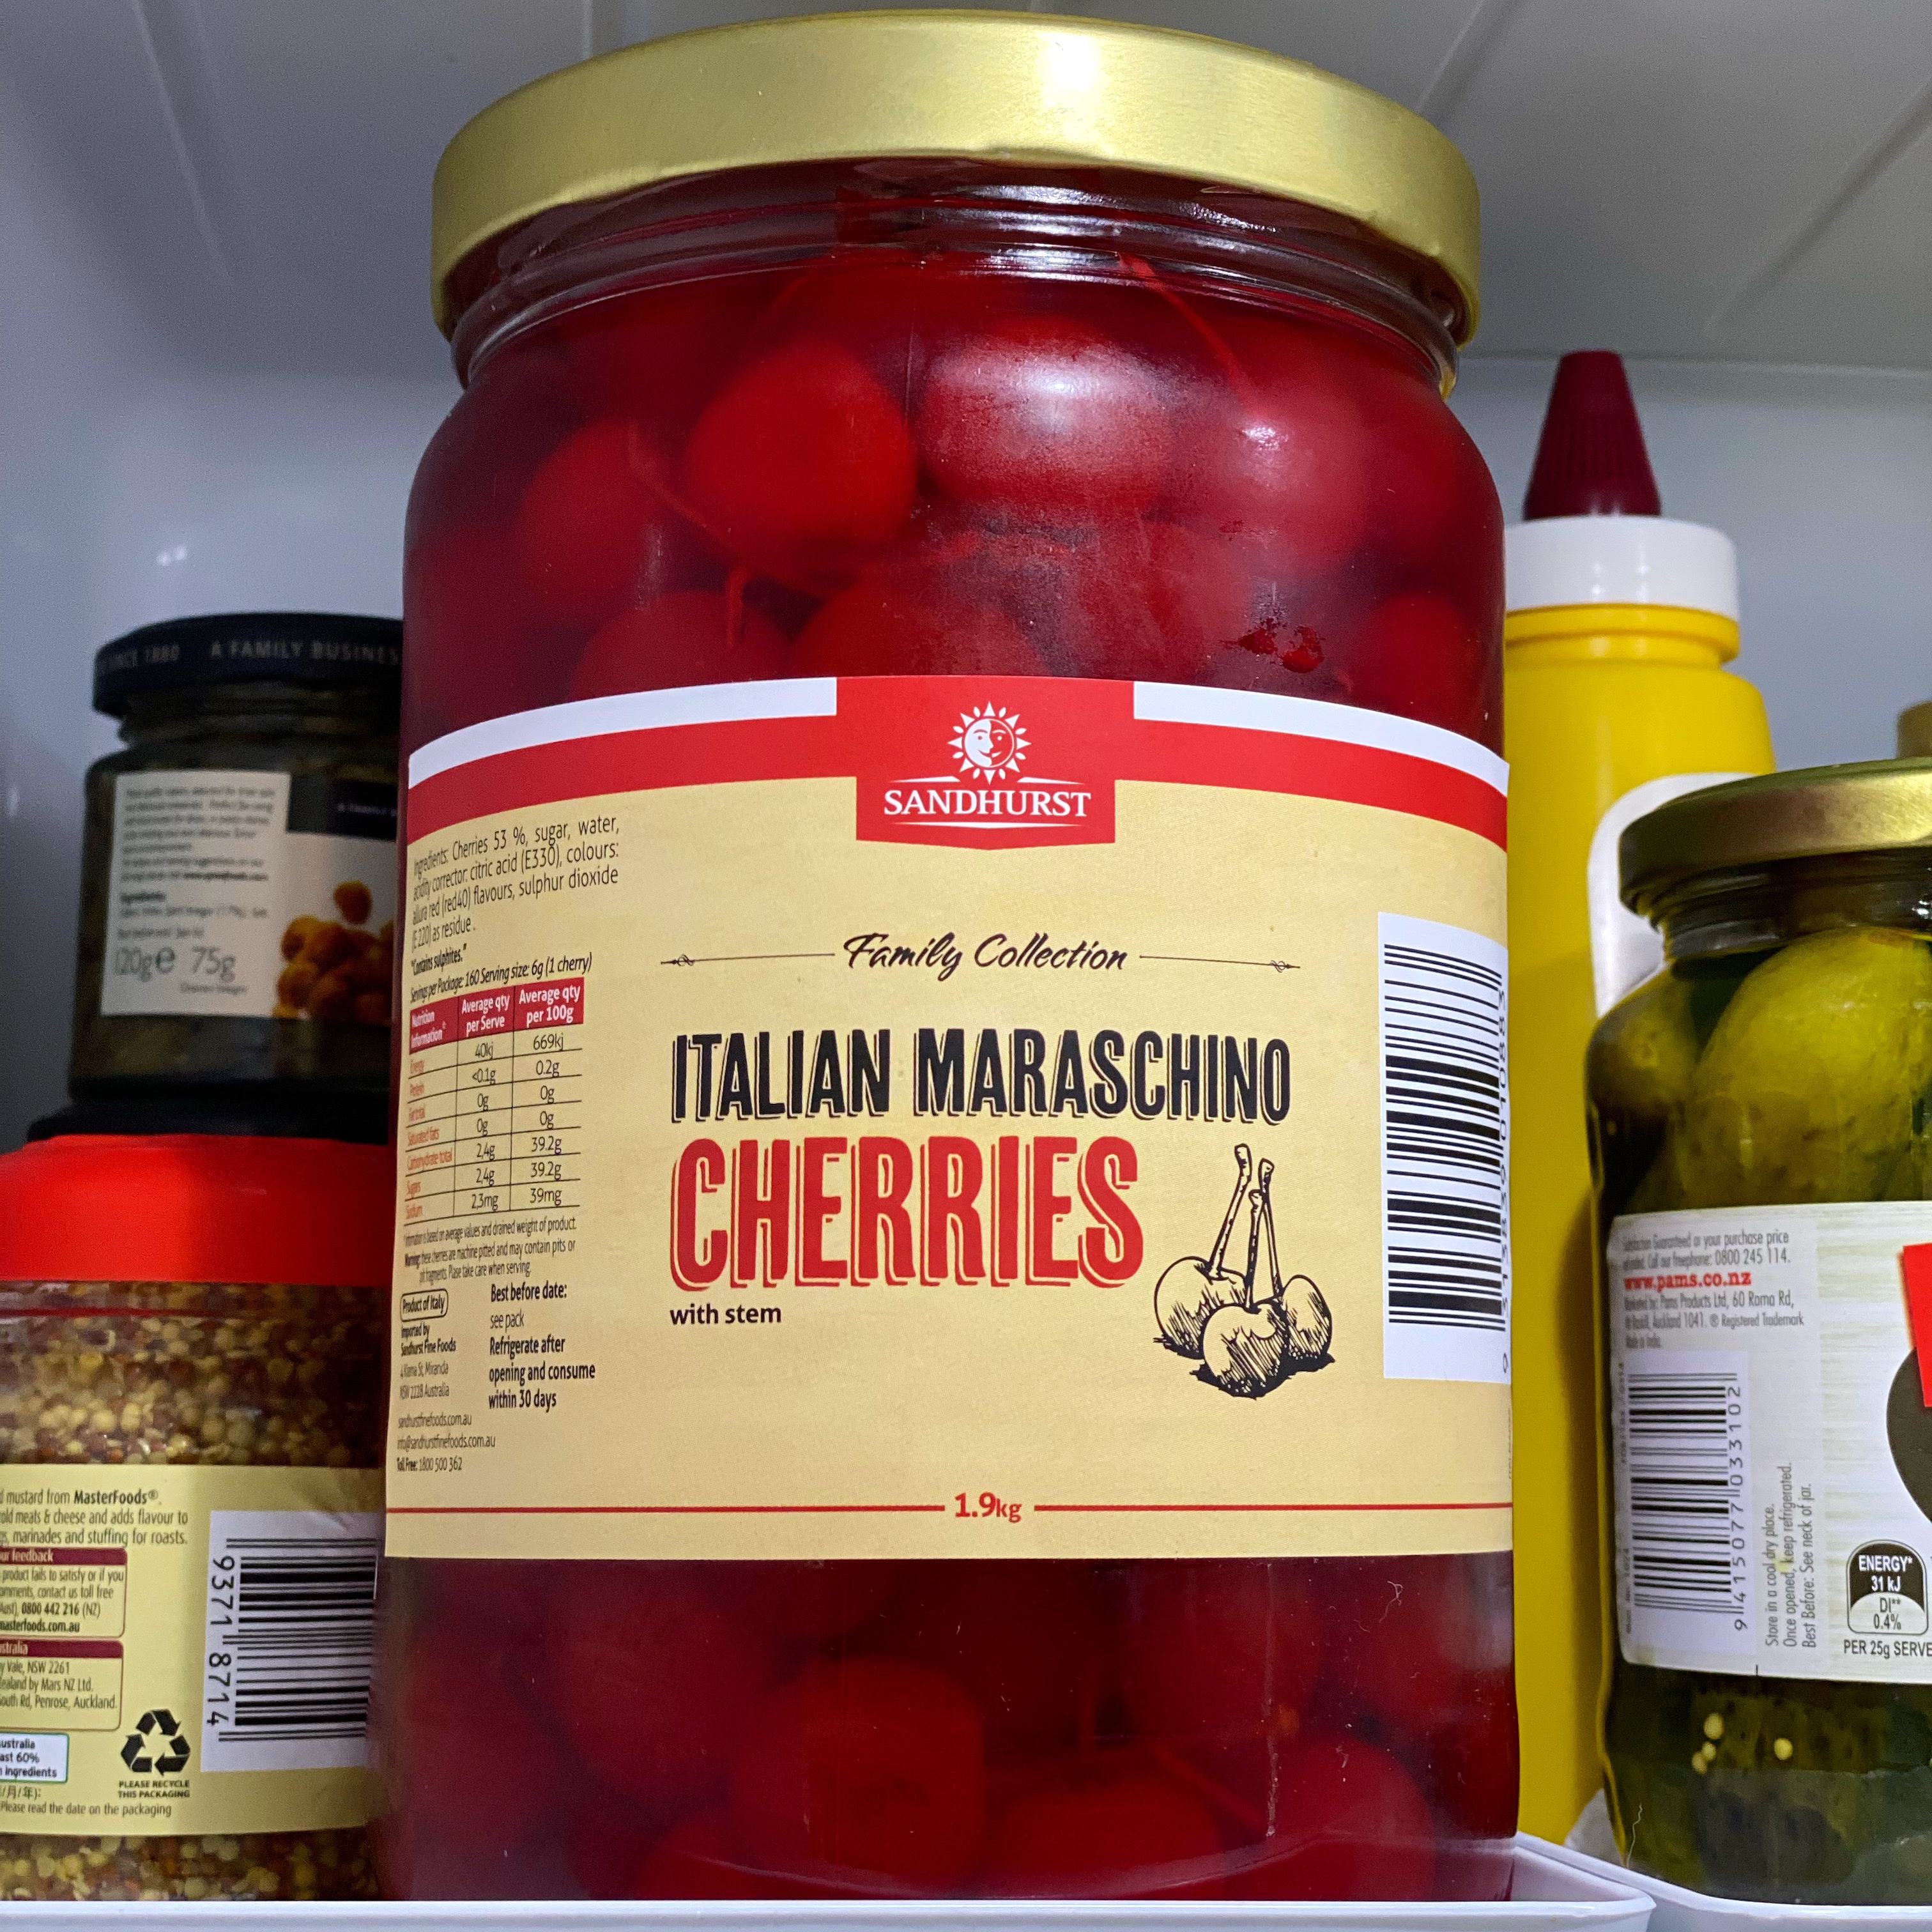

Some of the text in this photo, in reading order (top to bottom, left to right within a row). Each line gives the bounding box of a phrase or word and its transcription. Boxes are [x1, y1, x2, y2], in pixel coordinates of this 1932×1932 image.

[883, 789, 1092, 818] SANDHURST
[452, 815, 620, 861] Cherries 53 sugar, water,
[470, 841, 620, 880] citric acid (E330), colours:
[442, 863, 619, 917] (red40) flavours, sulphur dioxide
[843, 932, 1127, 981] Family Collection
[465, 951, 593, 987] 160 Serving size: 6g cherry)
[461, 993, 510, 1015] Average qty
[519, 985, 581, 1006] Average qty
[466, 1015, 505, 1037] per Serve
[526, 1005, 574, 1029] per 100g
[533, 1032, 565, 1051] 669kj
[535, 1059, 560, 1077] 0.2g
[670, 1028, 1291, 1127] ITALIAN MARASCHINO
[477, 1093, 489, 1112] 0g
[539, 1085, 555, 1104] 0g
[476, 1118, 489, 1137] 0g
[539, 1110, 555, 1130] 0g
[531, 1135, 563, 1155] 39.2g
[530, 1161, 562, 1181] 39.2g
[529, 1188, 563, 1207] 39mg
[670, 1135, 1144, 1291] CHERRIES
[493, 1216, 538, 1238] drained weight
[1724, 1229, 1789, 1246] purchase price
[525, 1238, 567, 1258] contain pits
[1715, 1248, 1763, 1266] 0800 245
[488, 1261, 505, 1276] when
[491, 1280, 567, 1303] Best before date:
[1732, 1291, 1775, 1308] 60 Roma
[402, 1294, 445, 1315] Product of Italy
[670, 1303, 782, 1325] with stem
[490, 1308, 525, 1333] see pack
[1761, 1311, 1805, 1326] Trademark
[437, 1337, 457, 1353] Foods
[489, 1333, 566, 1360] Refrigerate after
[489, 1360, 595, 1387] opening and consume
[424, 1381, 450, 1398] Australia
[488, 1388, 557, 1413] within 30 days
[434, 1456, 463, 1472] 500 362
[6, 1488, 70, 1505] mustard from
[15, 1508, 188, 1525] meats cheese and adds flavour to
[954, 1491, 1023, 1523] 1.9kg
[13, 1528, 62, 1544] marinades
[65, 1528, 85, 1544] and
[87, 1528, 128, 1547] stuffing
[132, 1527, 147, 1544] for
[151, 1529, 188, 1545] roasts.
[12, 1547, 54, 1563] feedback
[1777, 1462, 1798, 1647] Once opened, keep refrigerated.
[59, 1567, 124, 1584] satisfy you
[1761, 1503, 1779, 1646] Store in cool dry place.
[1797, 1483, 1816, 1648] Best Before: See neck of jar.
[38, 1585, 114, 1599] contact us toll free
[1871, 1575, 1901, 1591] 31 kJ
[22, 1602, 101, 1619] 0800 442 216 (NZ)
[1873, 1613, 1902, 1630] 0.4%
[206, 1555, 235, 1726] 9371 8714
[1843, 1639, 1932, 1659] PER 25g SERVE
[27, 1660, 70, 1675] NSW 2261
[29, 1676, 94, 1693] by Mars NZ Ltd.
[35, 1695, 118, 1710] Penrose, Auckland.
[16, 1752, 40, 1763] 60%
[118, 1790, 190, 1798] THIS PACKAGING
[119, 1780, 190, 1788] PLEASE RECYCLE
[27, 1801, 172, 1818] read the date on the packaging
